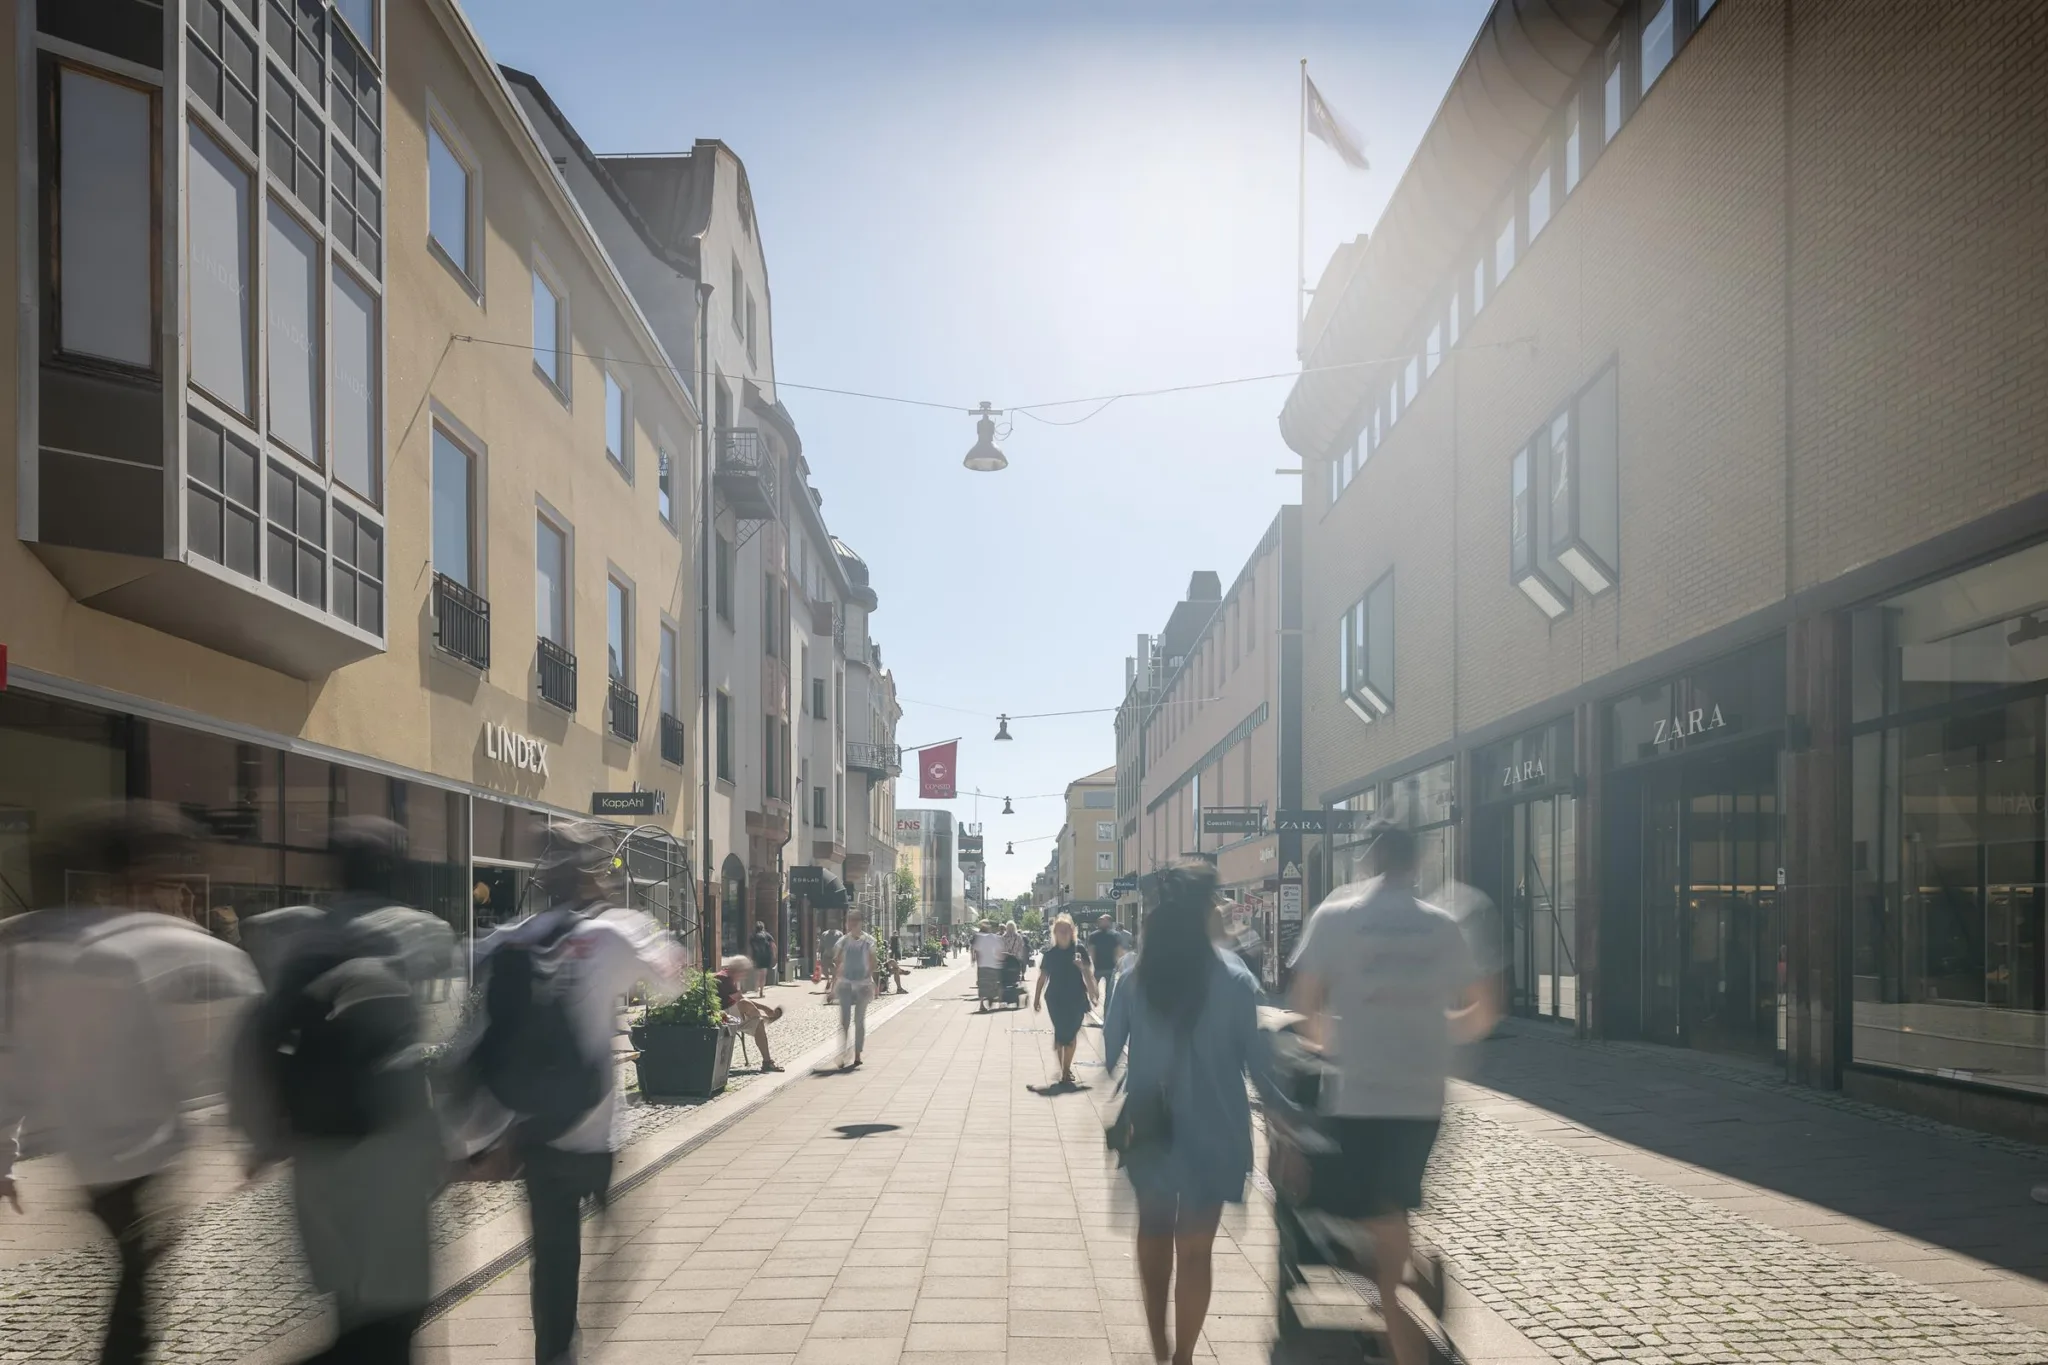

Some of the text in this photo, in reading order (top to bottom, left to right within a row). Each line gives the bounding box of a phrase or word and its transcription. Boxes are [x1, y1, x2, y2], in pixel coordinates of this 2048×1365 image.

[192, 243, 246, 300] LINDEX
[269, 308, 314, 356] LINDEX
[334, 360, 373, 404] LINDEX
[1653, 703, 1727, 746] ZARA
[486, 721, 550, 778] LINDEX
[1503, 758, 1546, 787] ZARA
[602, 798, 644, 810] KappAhl
[1280, 821, 1323, 829] ZARA
